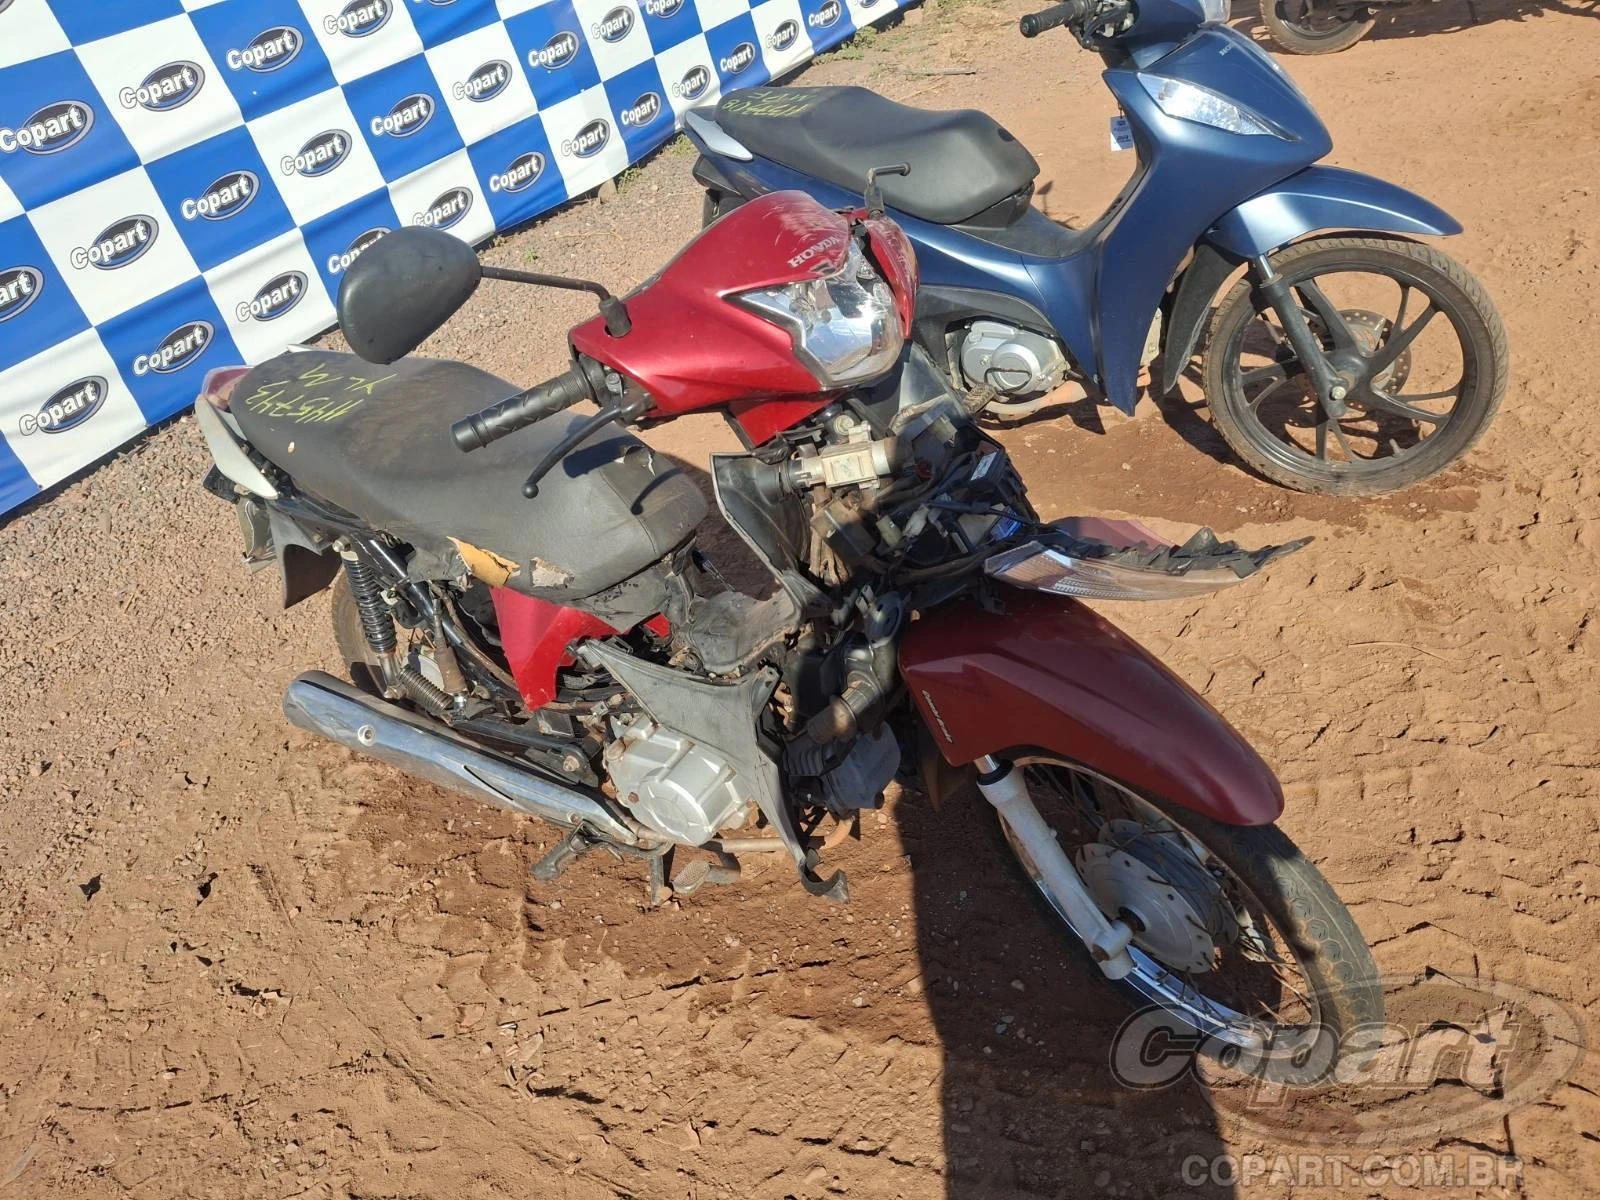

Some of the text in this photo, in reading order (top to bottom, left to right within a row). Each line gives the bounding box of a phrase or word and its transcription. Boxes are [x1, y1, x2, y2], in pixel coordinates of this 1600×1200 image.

[323, 0, 386, 35] Copart
[591, 11, 630, 39] Copart
[808, 3, 838, 27] Copart
[226, 29, 295, 72] Copart
[528, 35, 575, 67] Copart
[766, 22, 795, 48] Copart
[719, 44, 752, 72] Copart
[119, 65, 194, 109] Copart
[452, 64, 506, 100] Copart
[672, 69, 706, 97] Copart
[0, 104, 83, 153] Copart
[370, 96, 428, 136] Copart
[620, 94, 657, 126] Copart
[280, 133, 344, 176] Copart
[561, 122, 605, 156] Copart
[489, 154, 540, 193] Copart
[180, 173, 250, 221] Copart
[412, 189, 465, 227] Copart
[70, 218, 148, 270] Copart
[787, 236, 840, 268] HONDA
[0, 270, 33, 304] art
[236, 273, 299, 322] Copart
[132, 323, 206, 376] Copart
[19, 379, 97, 436] Copart
